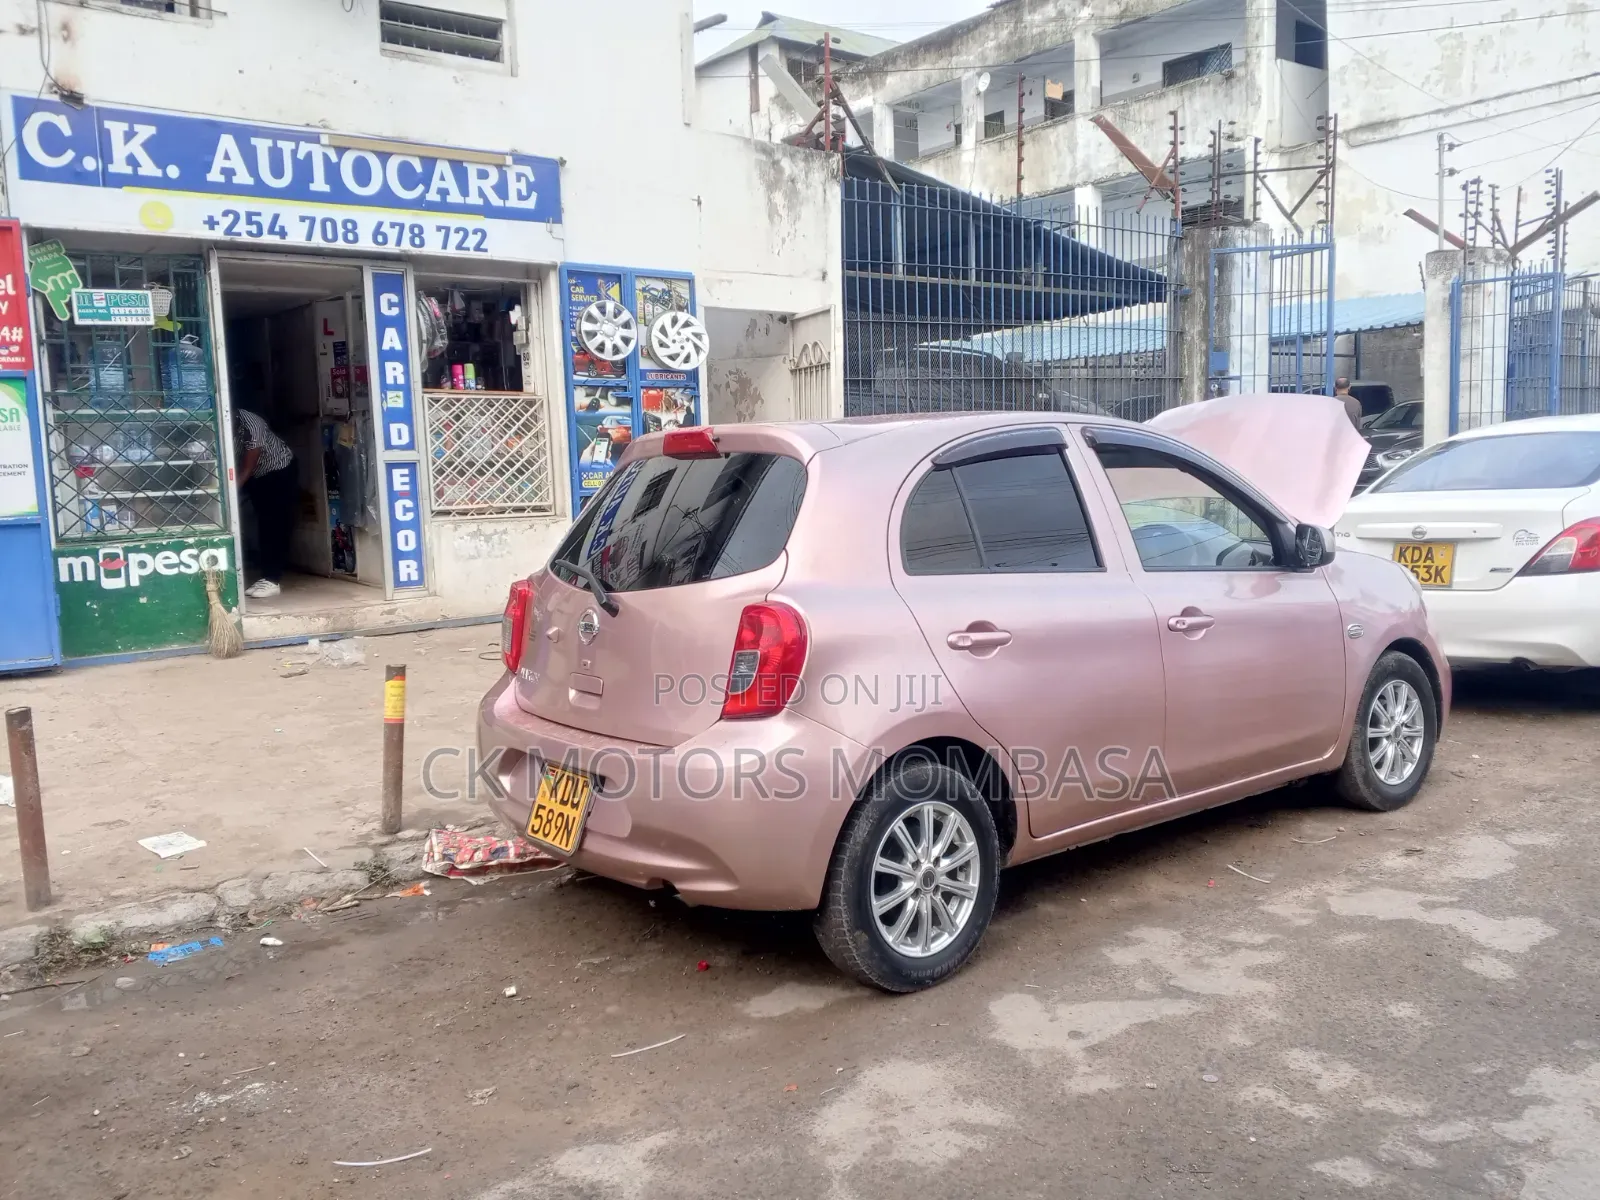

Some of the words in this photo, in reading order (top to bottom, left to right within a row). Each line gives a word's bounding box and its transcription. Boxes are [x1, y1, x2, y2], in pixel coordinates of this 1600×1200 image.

[21, 111, 180, 179] C.K.
[206, 133, 538, 210] AUTOCARE
[202, 209, 288, 240] +254
[299, 215, 359, 244] 708
[372, 220, 426, 249] 678
[436, 225, 489, 253] 722
[571, 294, 598, 302] SERVICE
[646, 372, 687, 380] LUBRICANTS
[1397, 545, 1435, 564] KDA
[1402, 564, 1447, 584] 53K
[531, 804, 576, 848] 589N
